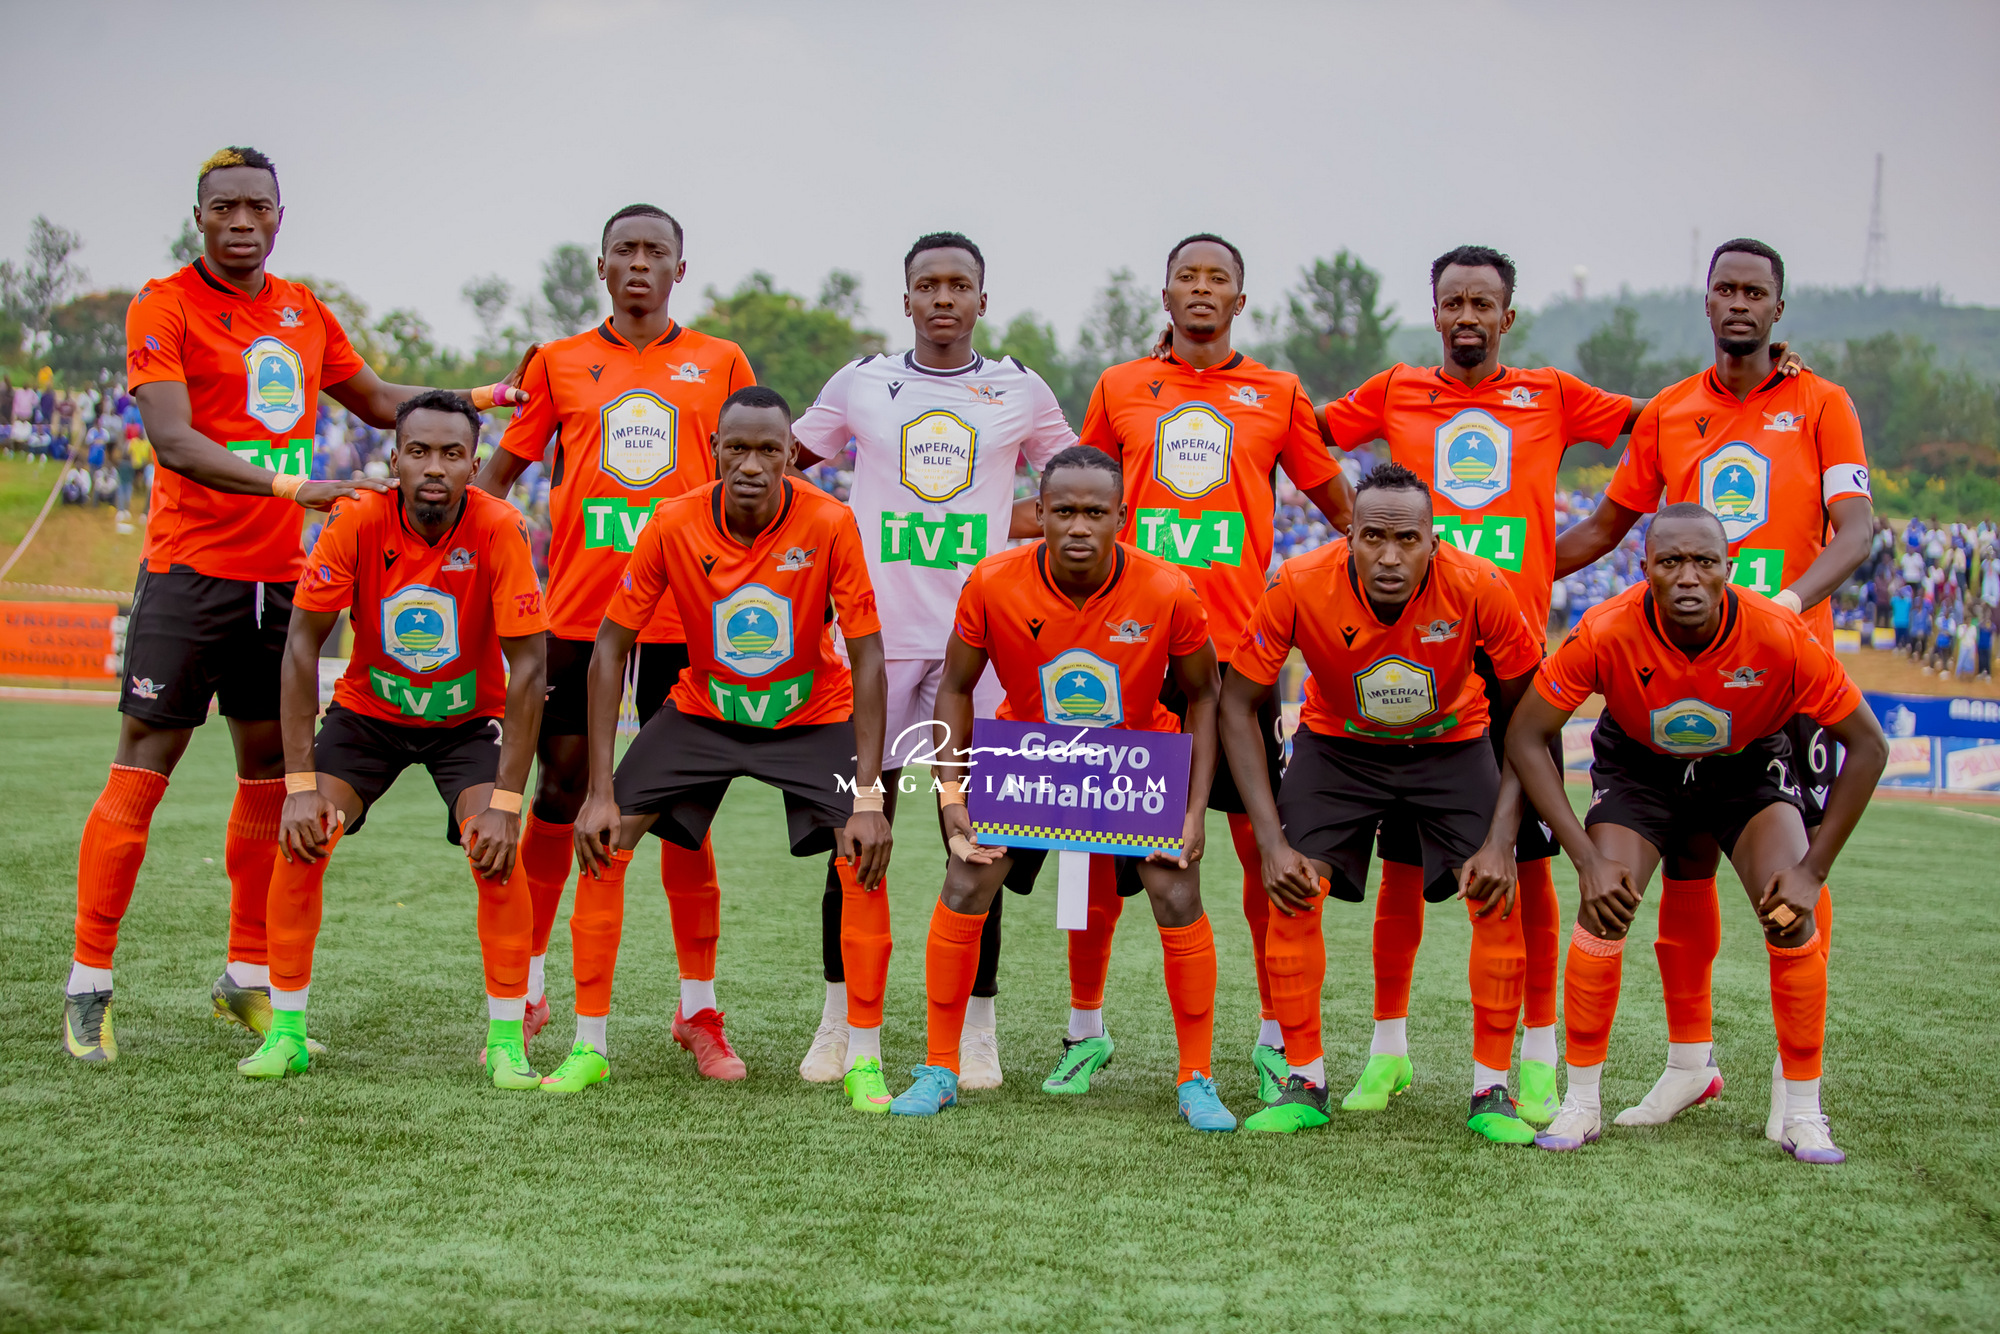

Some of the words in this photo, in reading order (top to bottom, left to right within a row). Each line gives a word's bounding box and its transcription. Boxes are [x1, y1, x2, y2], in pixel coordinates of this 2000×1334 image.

[612, 426, 667, 441] IMPERIAL
[625, 439, 653, 449] BLUE
[910, 442, 966, 460] IMPERIAL
[1166, 438, 1221, 455] IMPERIAL
[1179, 451, 1207, 462] BLUE
[923, 455, 952, 466] BLUE
[588, 506, 649, 546] TV
[1141, 516, 1233, 558] TV1
[885, 519, 977, 561] TV1
[373, 672, 468, 715] TV1
[711, 680, 803, 722] TV1
[1366, 687, 1425, 699] IMPERIAL
[1382, 696, 1412, 705] BLUE
[1949, 698, 2000, 723] MAR
[1020, 731, 1151, 775] Gerayo
[1809, 727, 1828, 773] 6
[996, 773, 1165, 815] Amahoro
